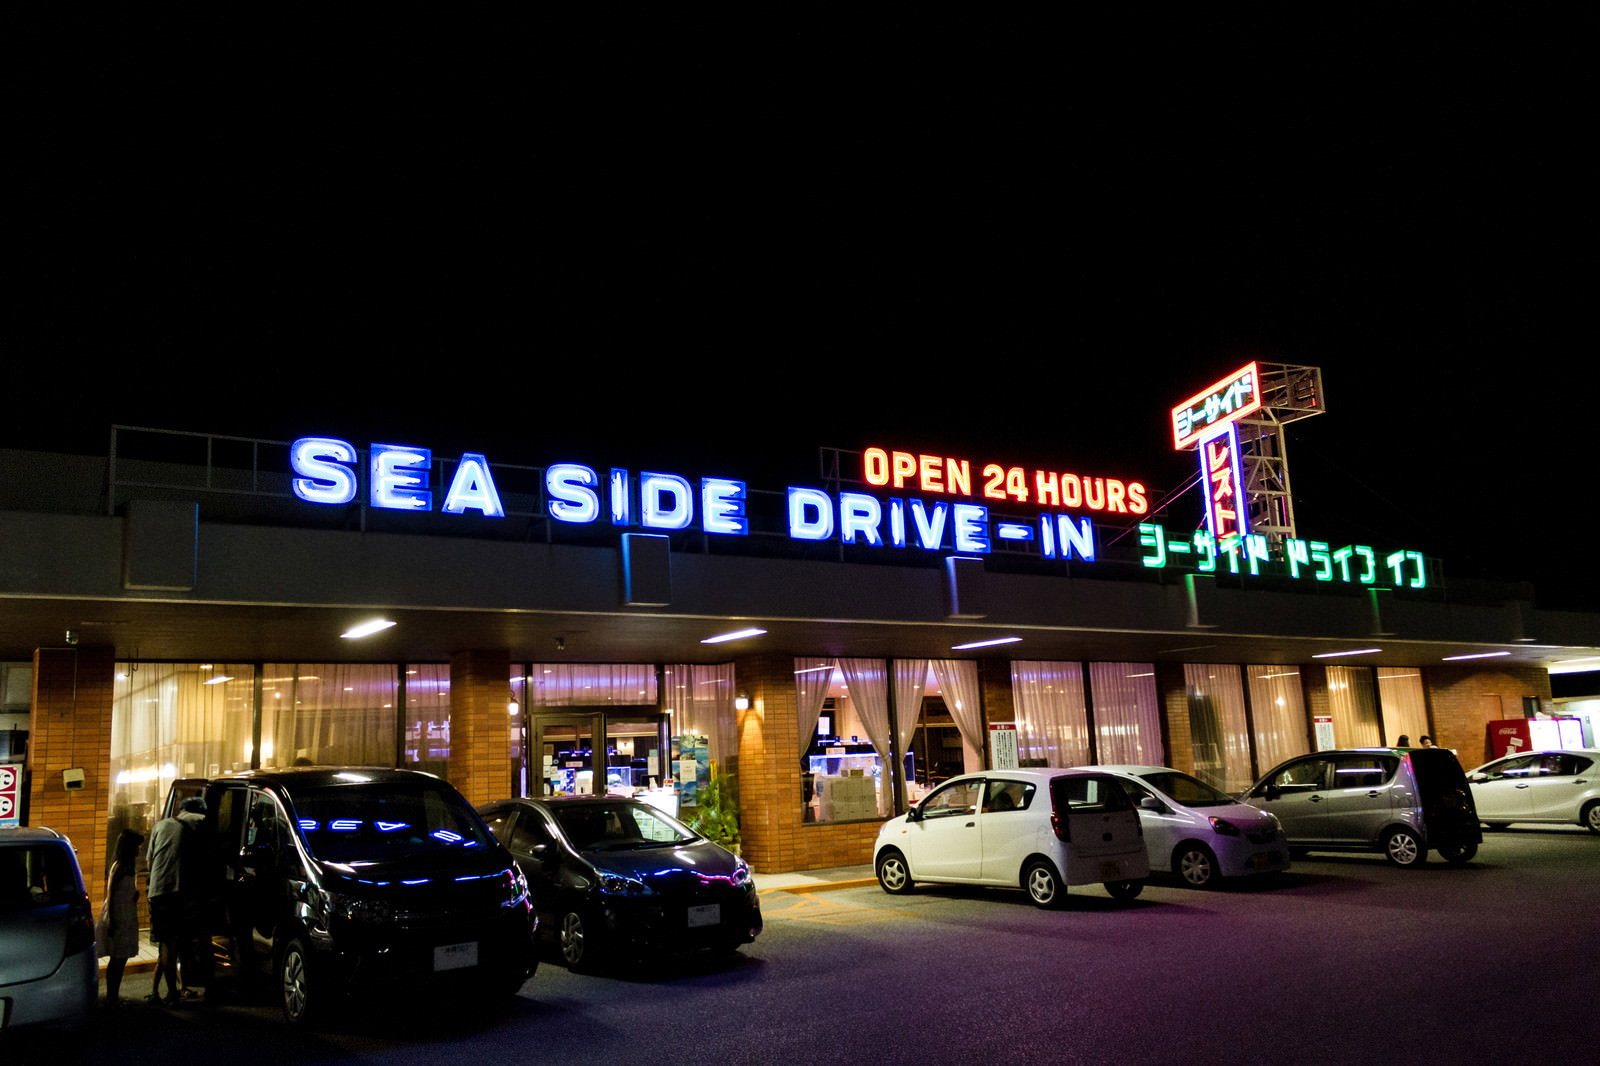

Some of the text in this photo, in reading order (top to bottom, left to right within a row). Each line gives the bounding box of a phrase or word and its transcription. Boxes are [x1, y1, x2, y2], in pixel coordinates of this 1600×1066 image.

[1176, 373, 1252, 440] シーサイド
[291, 437, 1096, 563] SEA SIDE DRIVE-IN
[863, 447, 1148, 515] OPEN 24 HOURS
[1139, 522, 1270, 576] シーサイド
